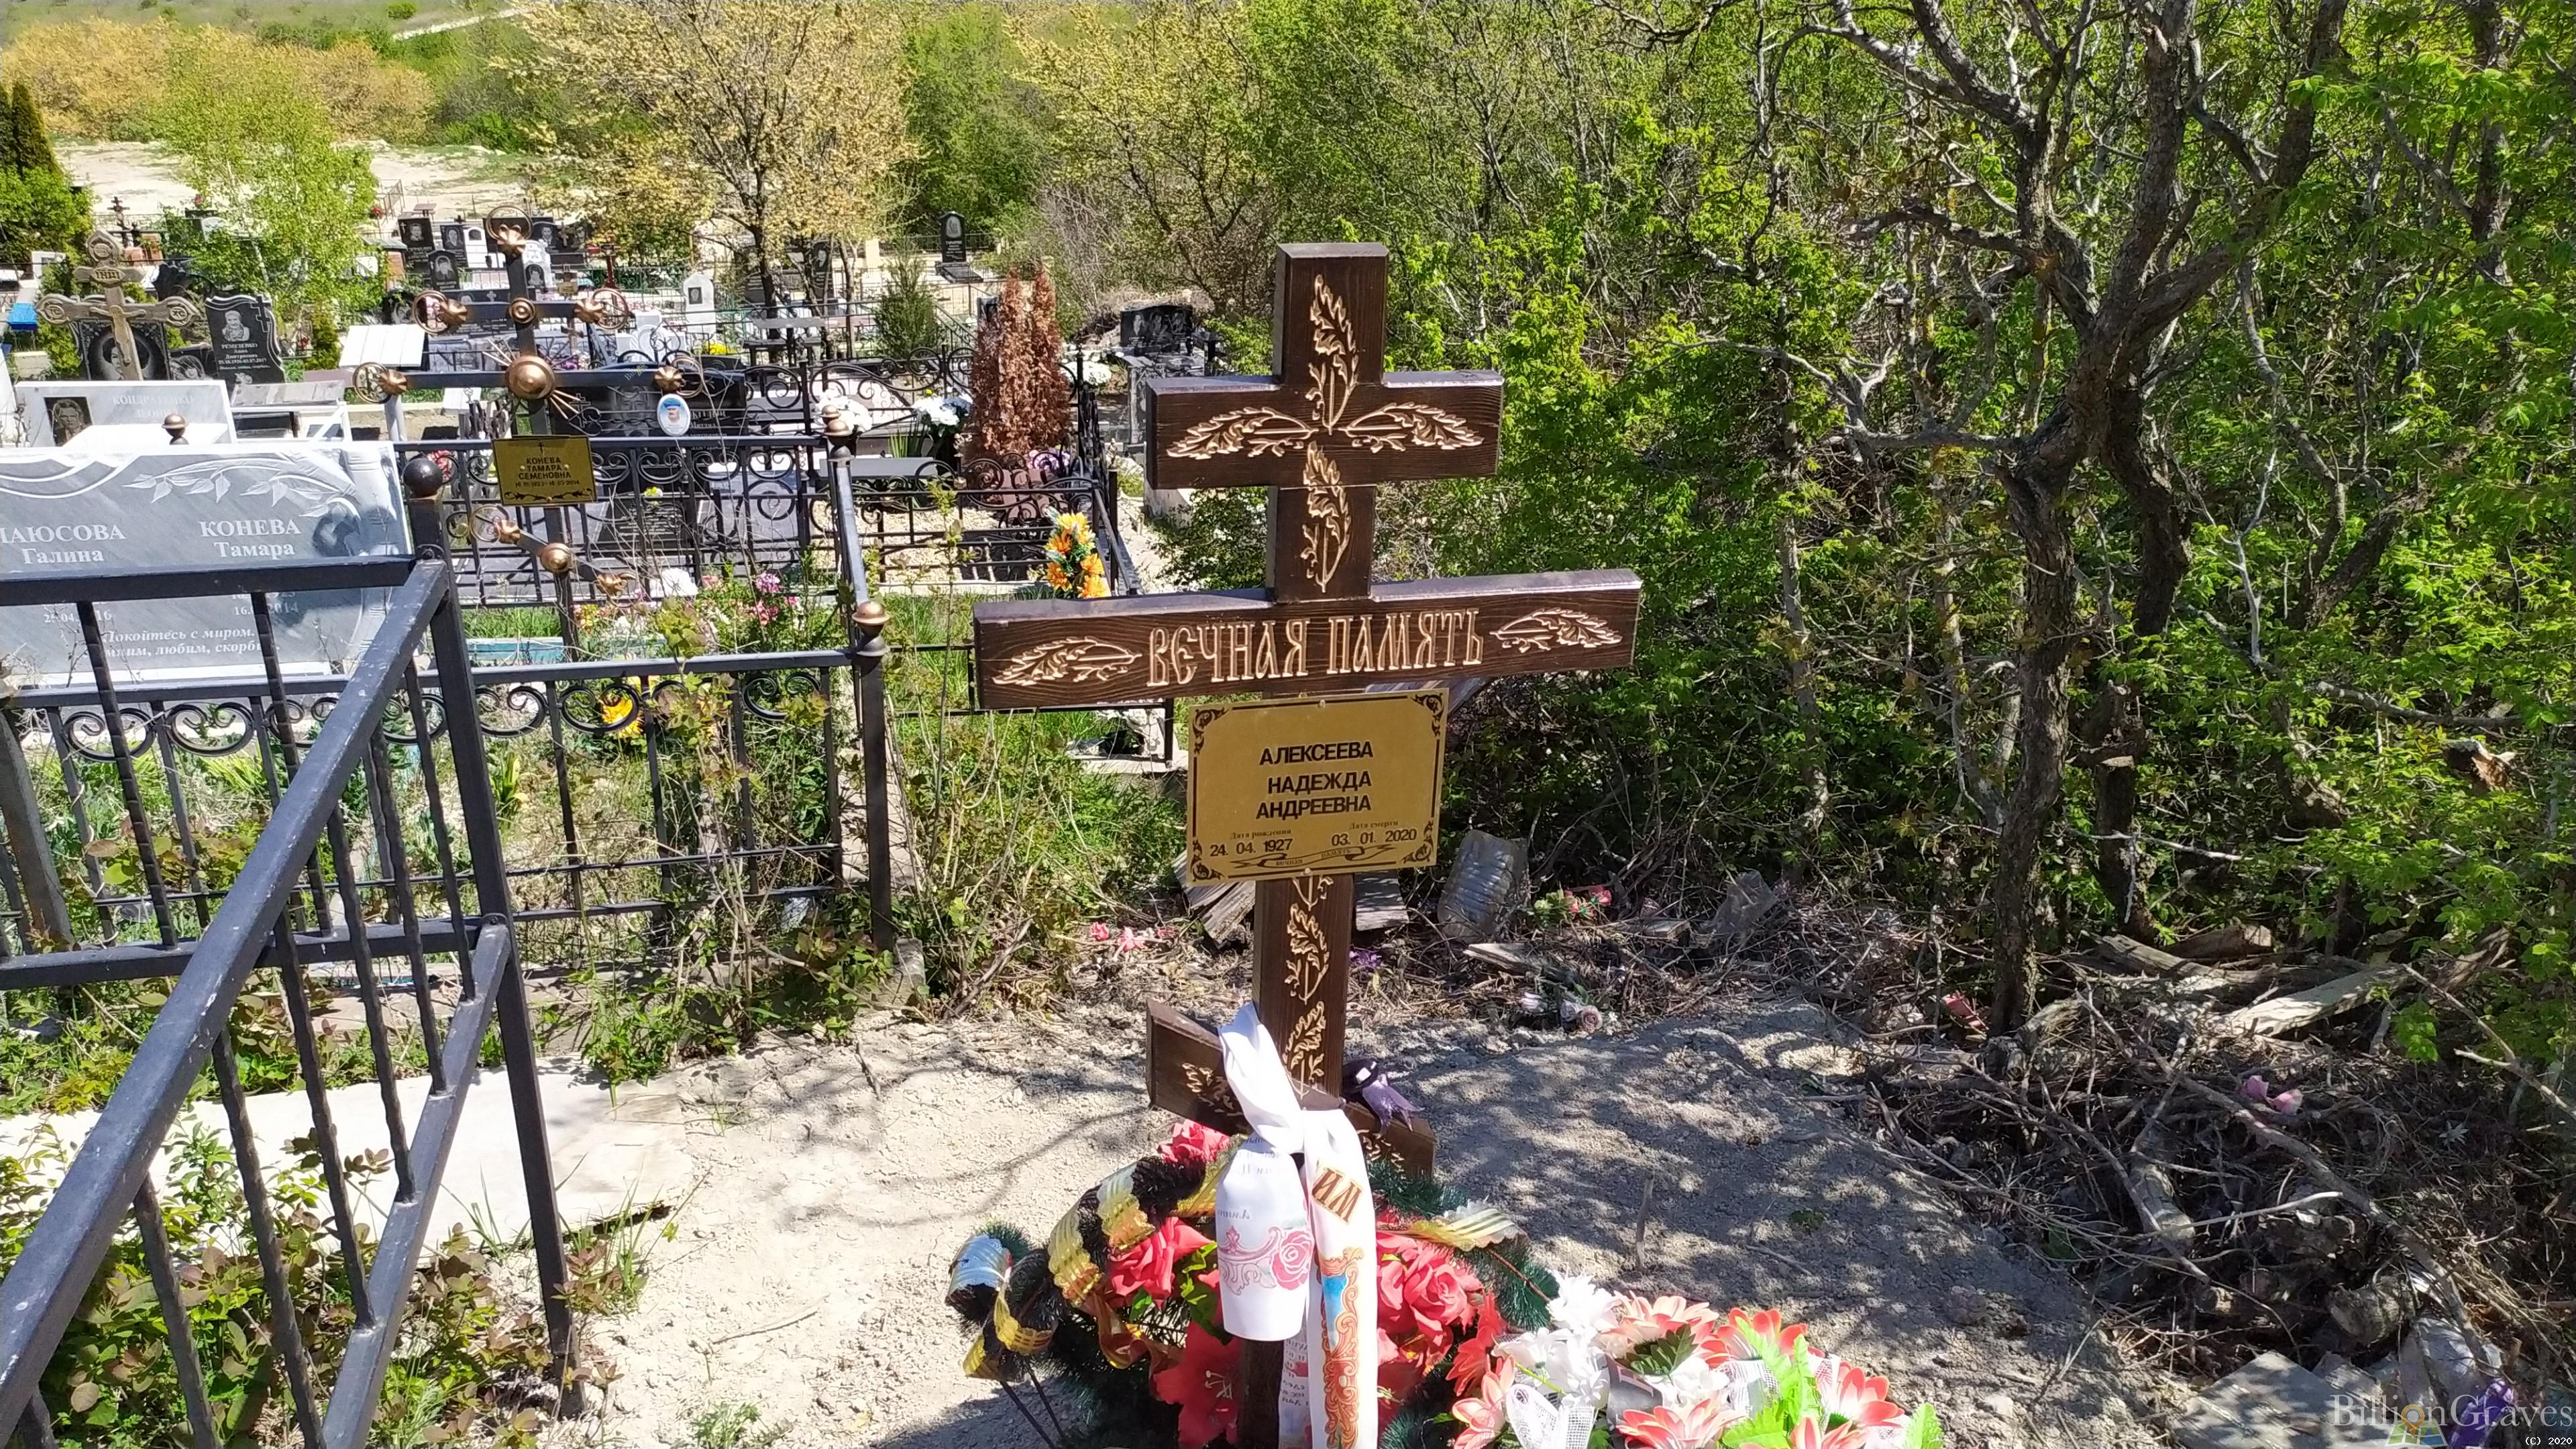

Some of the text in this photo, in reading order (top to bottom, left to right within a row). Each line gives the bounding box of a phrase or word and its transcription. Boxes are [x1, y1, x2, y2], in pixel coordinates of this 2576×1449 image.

[527, 457, 561, 465] КОНЕВА
[527, 464, 562, 472] ТАМАРА
[519, 472, 572, 480] СЕМЕНОВНА
[199, 519, 303, 537] КОНЕВА
[21, 548, 105, 564] Галина
[213, 541, 296, 560] Тамара
[191, 631, 199, 639] с
[1146, 607, 1485, 688] ВЕЧНАЯ ПАМЯТЬ
[1259, 741, 1374, 765] АЛЕКСЕЕВА
[1268, 771, 1372, 796] НАДЕЖДА
[1256, 794, 1372, 820] АНДРЕЕВНА
[1331, 828, 1417, 847] 03. 01. 2020
[1210, 838, 1293, 857] 24. 04. 1927
